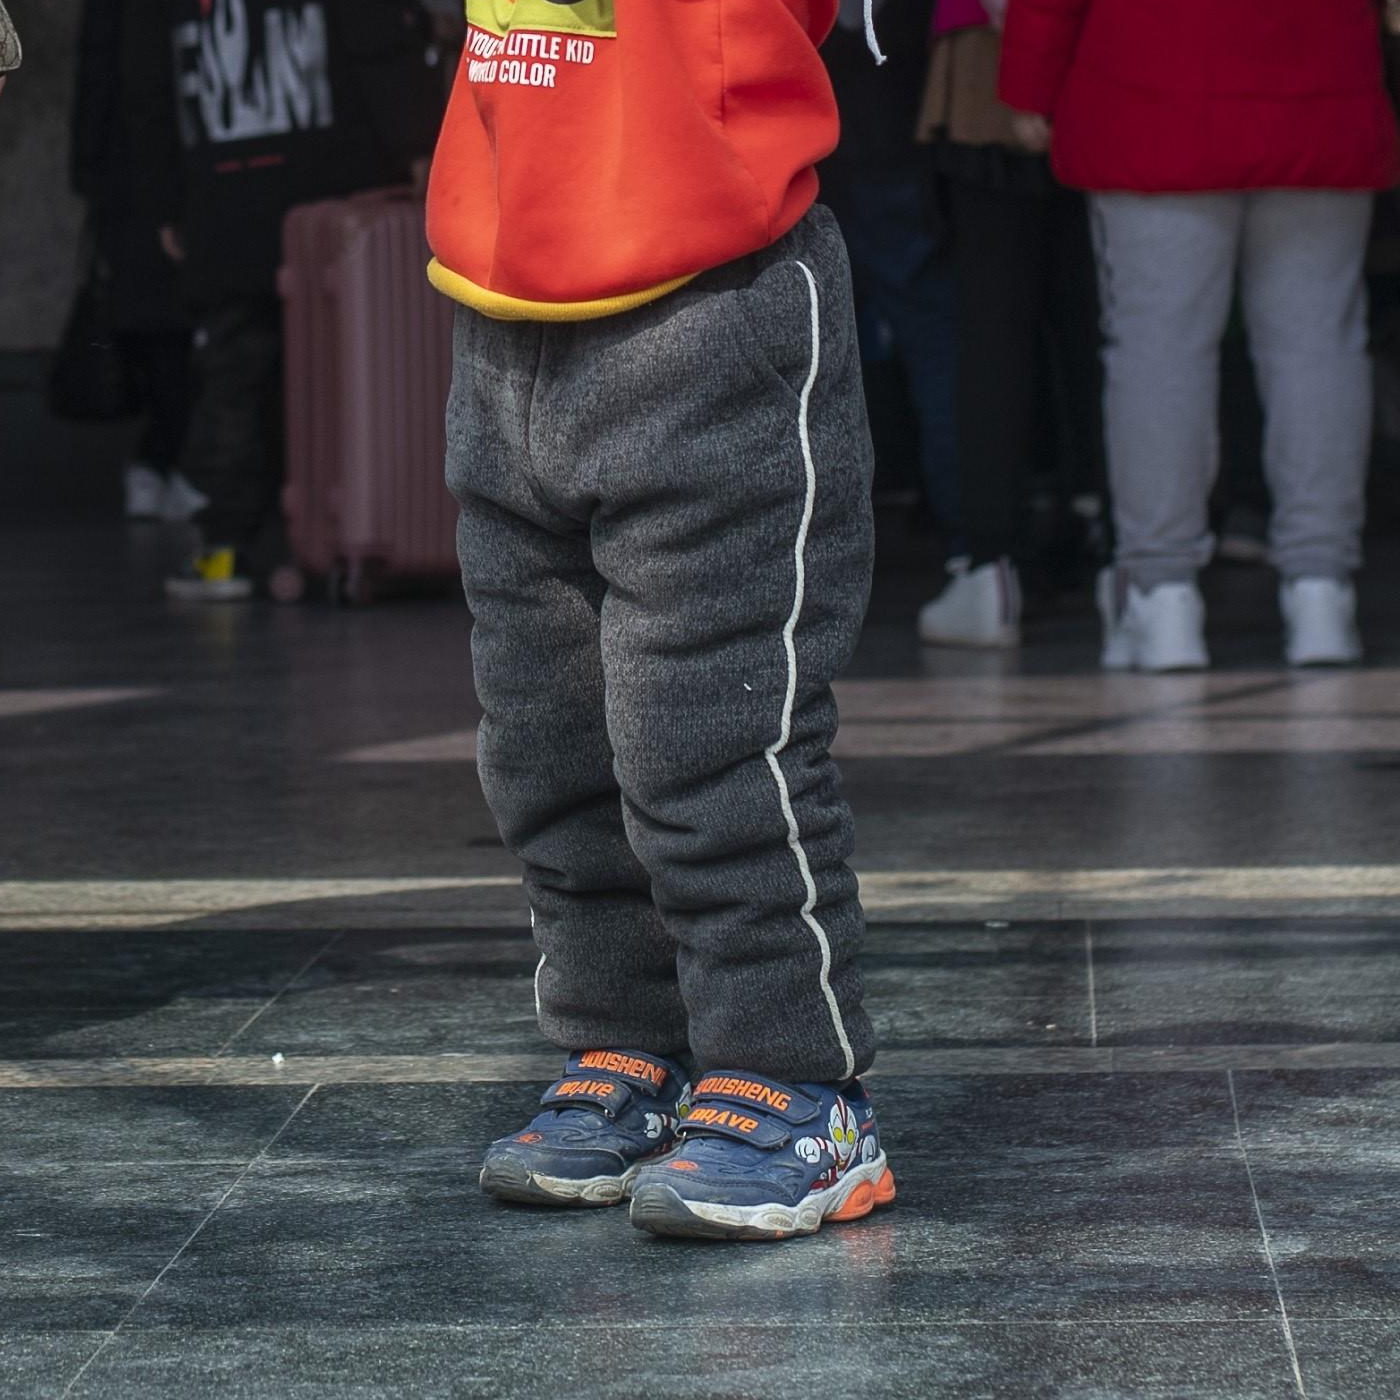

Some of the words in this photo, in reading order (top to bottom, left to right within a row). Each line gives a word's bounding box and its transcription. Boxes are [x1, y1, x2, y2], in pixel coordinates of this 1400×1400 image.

[507, 34, 561, 60] LITTLE
[565, 40, 595, 64] KID
[498, 60, 556, 88] COLOR
